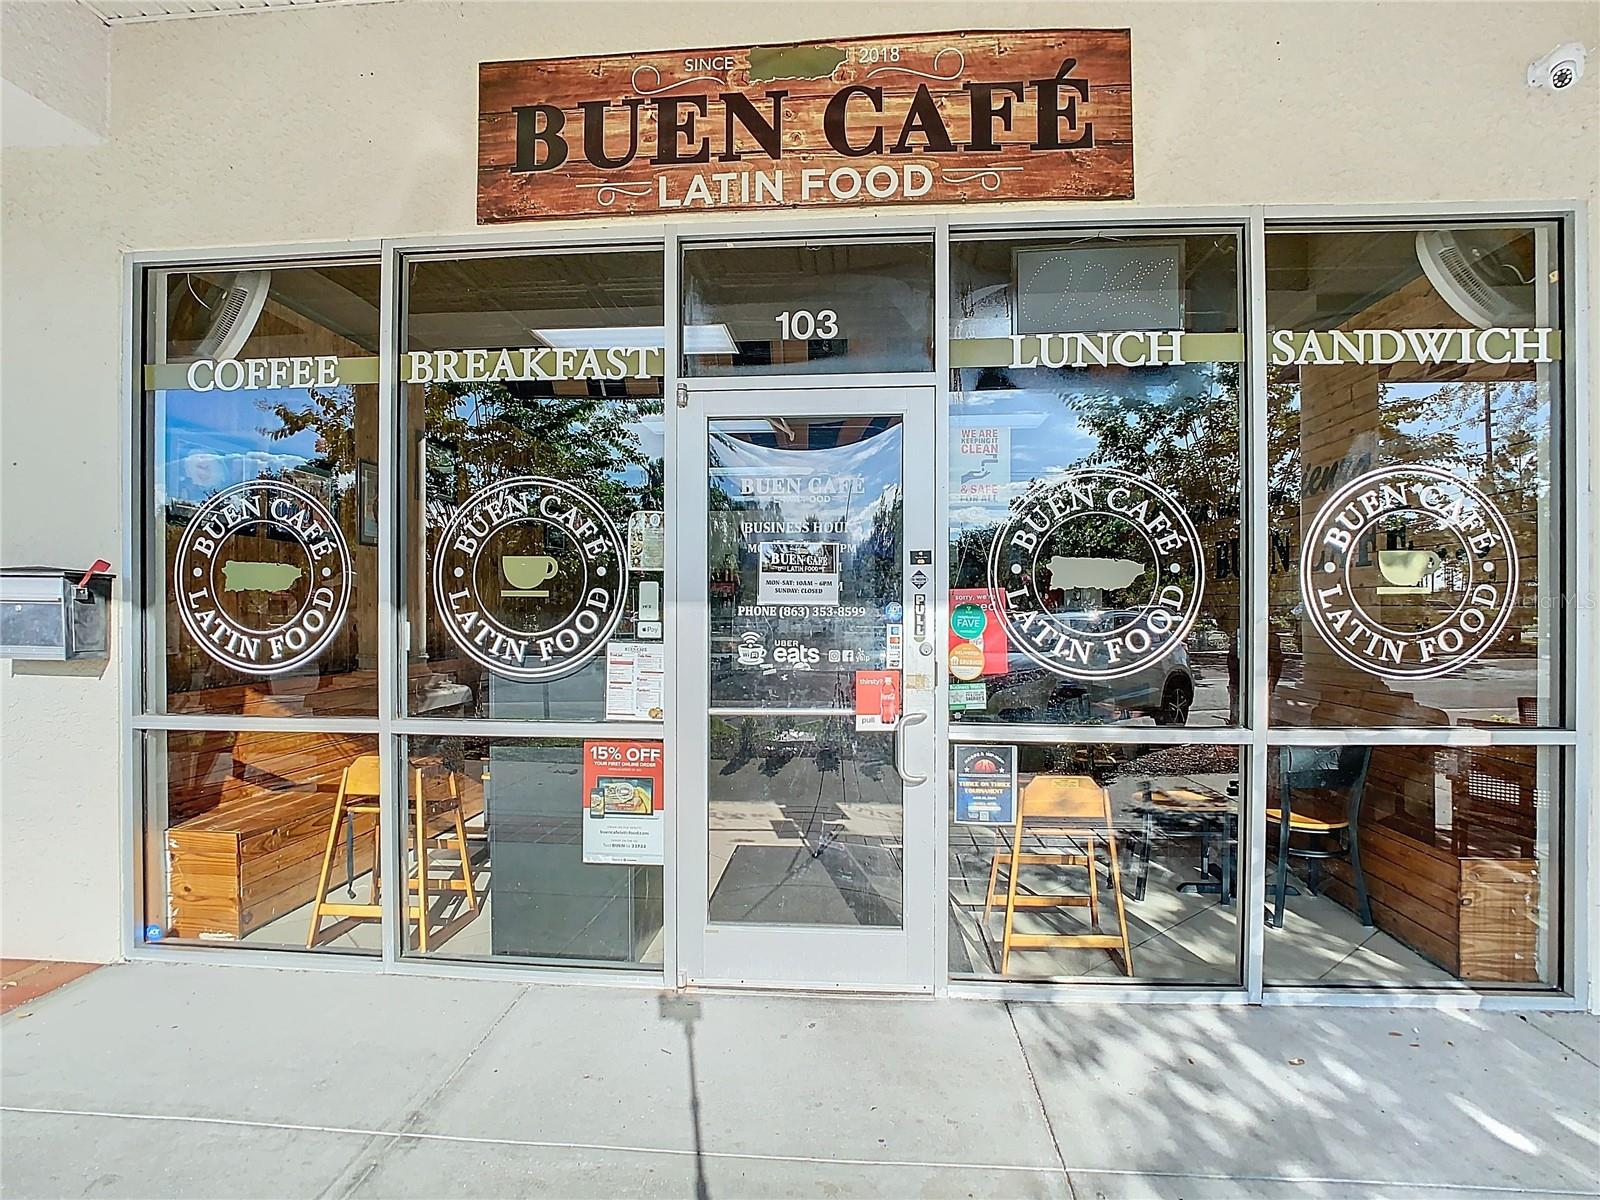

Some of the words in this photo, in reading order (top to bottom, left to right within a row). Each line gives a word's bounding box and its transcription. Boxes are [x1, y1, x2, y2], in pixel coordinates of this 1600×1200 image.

[684, 56, 734, 72] SINCE
[858, 47, 900, 64] 2018
[510, 89, 789, 173] BUEN
[823, 58, 1095, 157] CAFÉ
[658, 169, 784, 208] LATIN
[801, 164, 934, 201] FOOD
[775, 310, 839, 341] 103
[1008, 330, 1186, 369] LUNCH
[1272, 327, 1554, 367] SANDWICH
[187, 355, 339, 392] COFFEE
[406, 346, 661, 384] BREAKFAST
[961, 429, 977, 438] WE
[979, 429, 998, 438] ARE
[961, 444, 998, 454] CLEAN
[740, 478, 801, 495] BUEN
[808, 473, 865, 495] CAFÉ
[960, 484, 968, 494] &
[970, 484, 998, 494] SAFE
[193, 495, 262, 559] BUEN
[271, 498, 338, 560] CAFÉ
[454, 491, 529, 558] BUEN
[540, 495, 613, 560] CAFÉ
[743, 521, 809, 534] BUSINESS
[1010, 485, 1095, 554] BUEN
[1106, 488, 1188, 556] CAFÉ
[1323, 481, 1409, 554] BUEN
[1419, 485, 1502, 555] CAFÉ
[771, 553, 803, 565] BUEN
[188, 587, 260, 661] LATIN
[267, 587, 335, 660] FOOD
[448, 587, 529, 664] LATIN
[536, 587, 610, 662] FOOD
[647, 624, 659, 633] Pay
[737, 606, 777, 616] PHONE
[779, 605, 809, 618] (863)
[812, 606, 866, 616] 353-8599
[914, 594, 926, 636] PULL
[957, 619, 980, 628] FAVE
[1006, 585, 1095, 665] LATIN
[1104, 585, 1185, 664] FOOD
[1318, 583, 1409, 665] LATIN
[1416, 583, 1499, 663] FOOD
[773, 645, 820, 663] eats
[859, 677, 883, 686] thirsty?
[861, 716, 876, 725] pull
[590, 746, 622, 760] 15%
[626, 747, 661, 762] OFF
